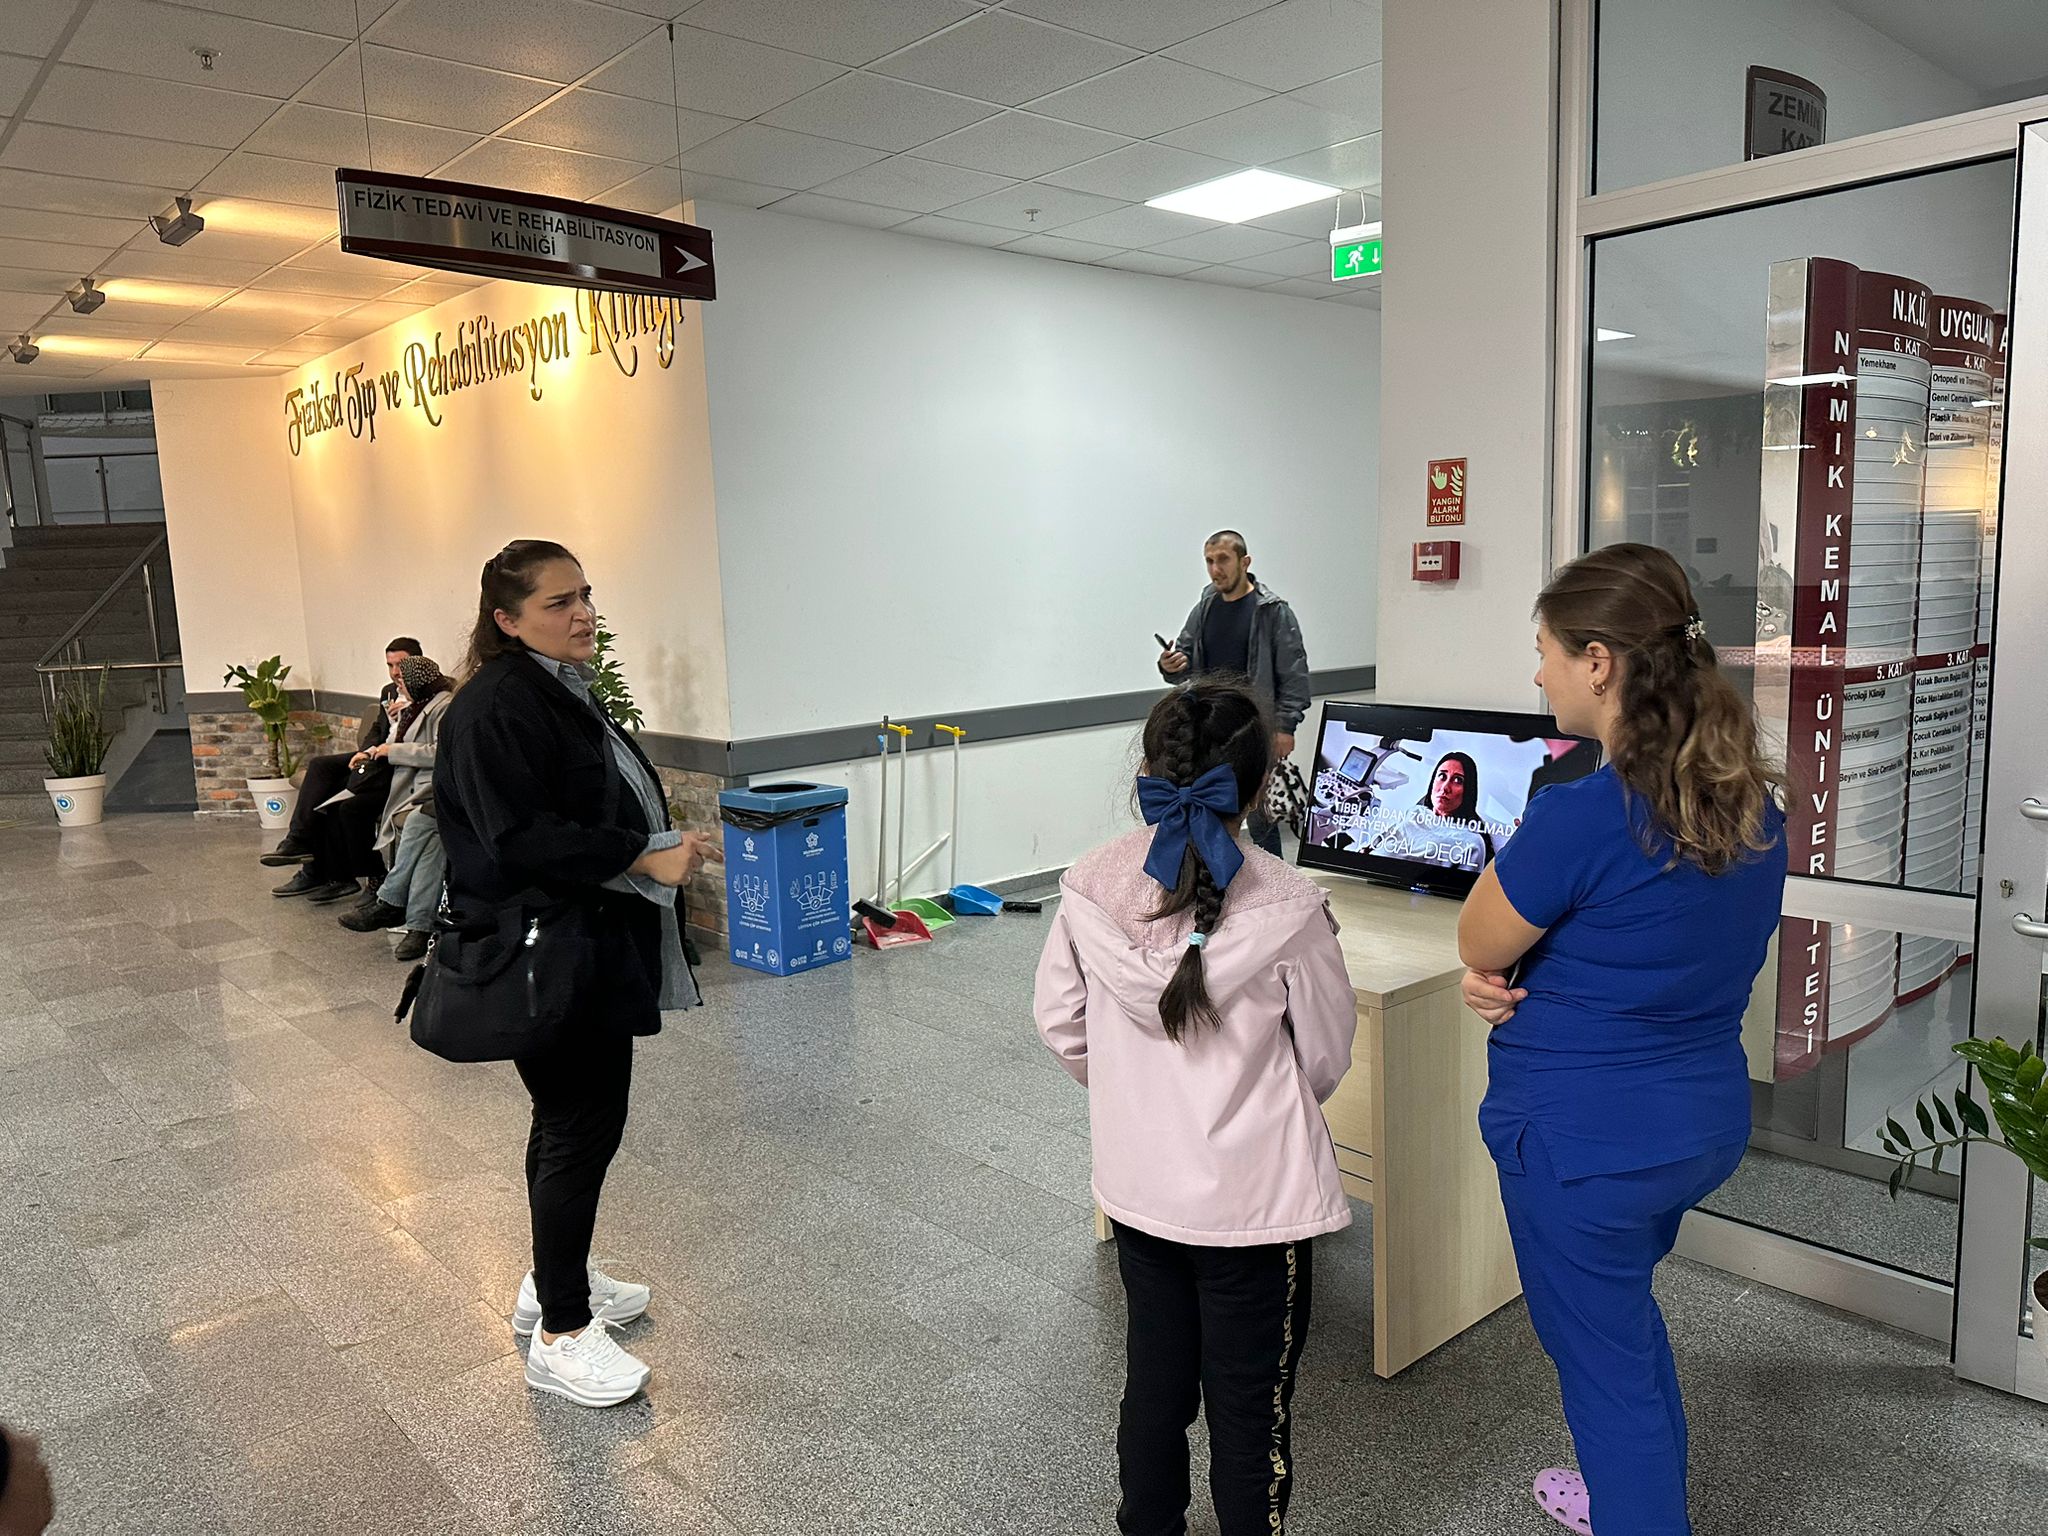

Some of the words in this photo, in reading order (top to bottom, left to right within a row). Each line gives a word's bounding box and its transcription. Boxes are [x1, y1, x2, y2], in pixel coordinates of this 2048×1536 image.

[1768, 91, 1821, 131] ZEMİN
[354, 188, 406, 212] FİZİK
[412, 196, 482, 221] TEDAVİ
[488, 207, 512, 226] VE
[518, 212, 655, 252] REHABİLİTASYON
[491, 230, 556, 256] KLİNİĞİ
[1893, 288, 1927, 329] N.K.Ü.
[1894, 337, 1902, 352] 6.
[1905, 339, 1921, 357] KAT
[1860, 357, 1897, 370] Yemekhane
[1964, 355, 1972, 369] 4.
[1974, 356, 1986, 371] KAT
[285, 372, 344, 456] Fiziksel
[379, 370, 402, 410] ve
[404, 312, 570, 426] Rehabilitasyon
[1933, 373, 1958, 385] Ortopedi
[1932, 393, 1949, 402] Genel
[1827, 330, 1851, 489] NAMIK
[1930, 413, 1951, 422] Plastik
[1432, 497, 1461, 506] YANGIN
[1432, 506, 1459, 515] ALARM
[1430, 514, 1461, 523] BUTONU
[1818, 514, 1842, 667] KEMAL
[1947, 653, 1954, 667] 3.
[1956, 650, 1969, 666] KAT
[1876, 665, 1885, 680] 5.
[1888, 662, 1903, 678] KAT
[1916, 676, 1933, 686] Kulak
[1915, 695, 1927, 705] Göz
[1914, 711, 1932, 725] Çocuk
[1913, 731, 1931, 744] Çocuk
[1913, 750, 1918, 759] 3.
[1839, 771, 1858, 783] Beyin
[1911, 765, 1938, 778] Konferans
[1335, 800, 1363, 816] TIBBİ
[1364, 806, 1406, 823] AÇIDAN
[1409, 811, 1466, 830] ZORUNLU
[1468, 820, 1517, 838] OLMAD
[1358, 828, 1419, 856] DOĞAL
[1423, 841, 1479, 868] DEĞİL
